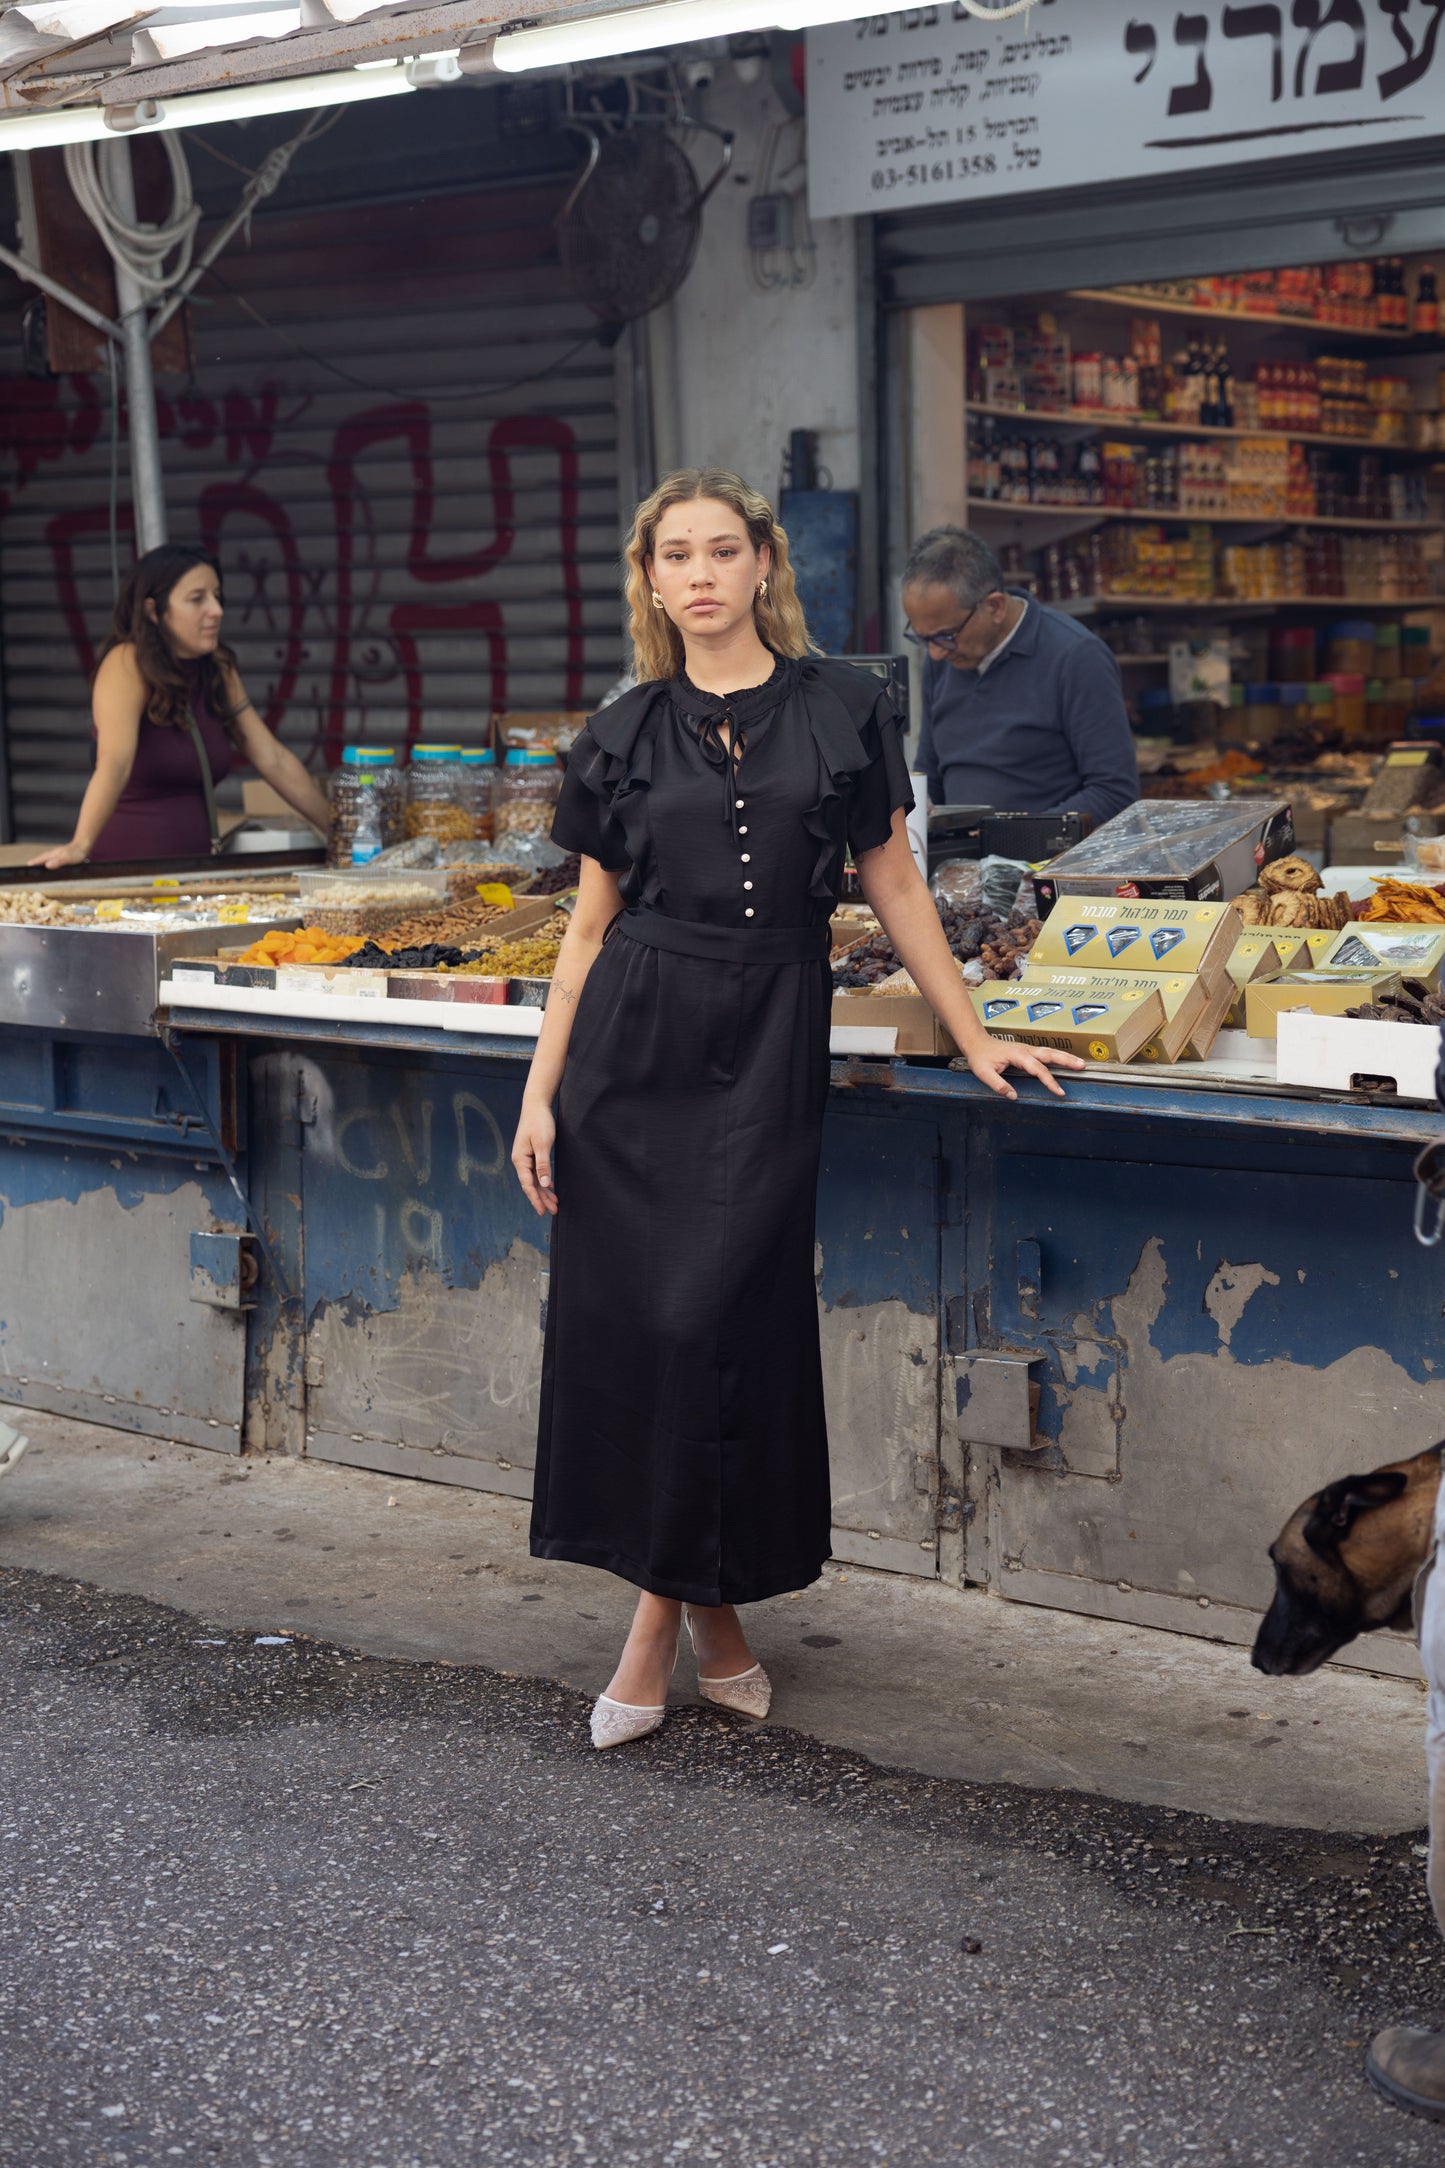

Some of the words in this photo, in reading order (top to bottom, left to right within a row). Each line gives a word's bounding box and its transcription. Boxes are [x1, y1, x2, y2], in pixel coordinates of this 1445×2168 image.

[1124, 0, 1445, 116] עמרני
[843, 66, 892, 91] יבשים
[898, 57, 942, 82] פירות
[956, 125, 977, 145] 15
[984, 116, 1038, 140] הכרמל
[871, 153, 997, 190] 03-5161358
[1081, 905, 1118, 918] מובחר
[1163, 908, 1189, 920] תמר
[1005, 986, 1042, 997] מובחר
[1089, 991, 1115, 1000] תמר
